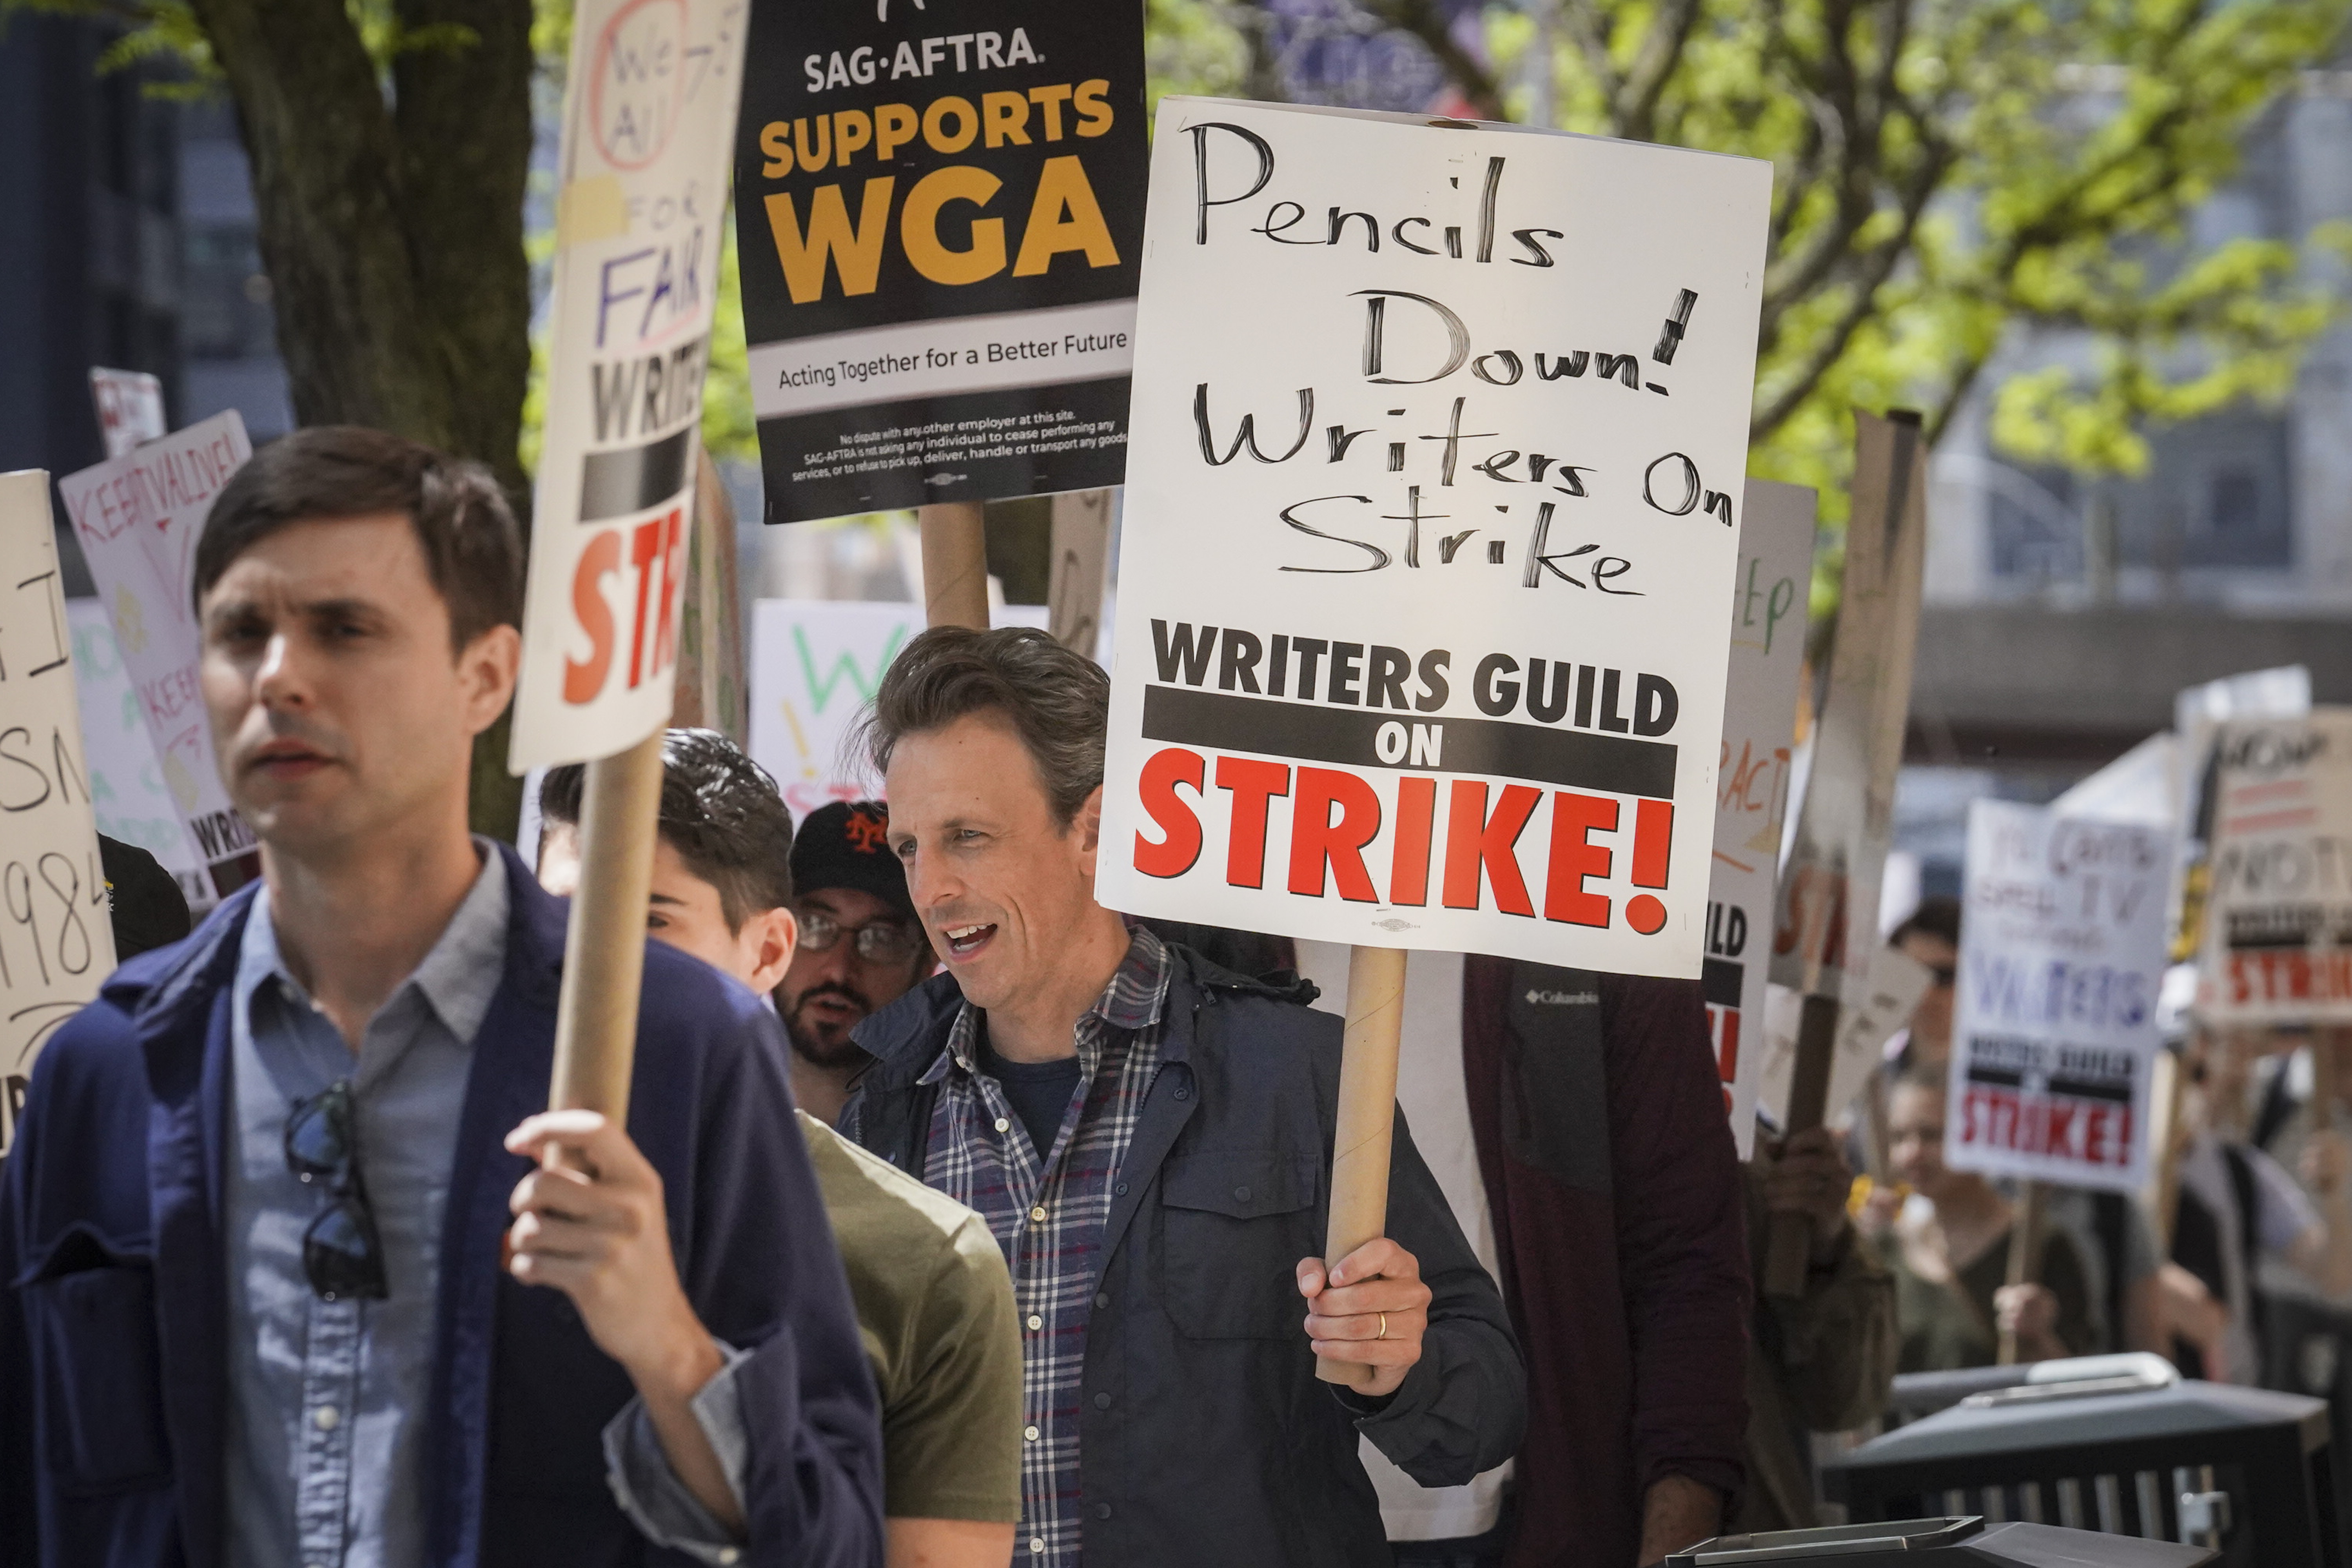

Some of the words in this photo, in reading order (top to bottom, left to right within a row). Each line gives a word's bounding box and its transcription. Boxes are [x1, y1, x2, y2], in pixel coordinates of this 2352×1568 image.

[759, 79, 1115, 179] SUPPORTS
[763, 154, 1121, 305] WGA
[1178, 122, 1564, 268] Pencils
[779, 365, 837, 389] Acting
[838, 352, 920, 381] Together
[926, 347, 958, 368] for
[965, 349, 979, 365] a
[987, 336, 1058, 363] Better
[1064, 330, 1127, 355] Future
[1347, 288, 1699, 397] Down!
[804, 448, 857, 465] SAG-AFTRA
[906, 440, 925, 452] any
[926, 432, 986, 448] individual
[989, 432, 1003, 442] to
[1004, 429, 1039, 441] cease
[1041, 421, 1095, 439] performing
[1097, 420, 1116, 432] any
[832, 466, 844, 476] or
[844, 464, 854, 474] to
[969, 446, 1013, 459] handle
[1015, 444, 1028, 454] or
[1031, 438, 1078, 454] transport
[1079, 437, 1096, 449] any
[882, 427, 901, 439] with
[924, 422, 955, 435] other
[958, 416, 1016, 432] employer
[1019, 415, 1031, 425] at
[1034, 411, 1054, 423] this
[1193, 383, 1599, 499] Writers
[1642, 451, 1733, 527] On
[1277, 485, 1646, 597] Strike
[1150, 618, 1450, 713] WRITERS
[1472, 653, 1679, 737] GUILD
[1374, 722, 1444, 768] ON
[1133, 746, 1674, 936] STRIKE!
